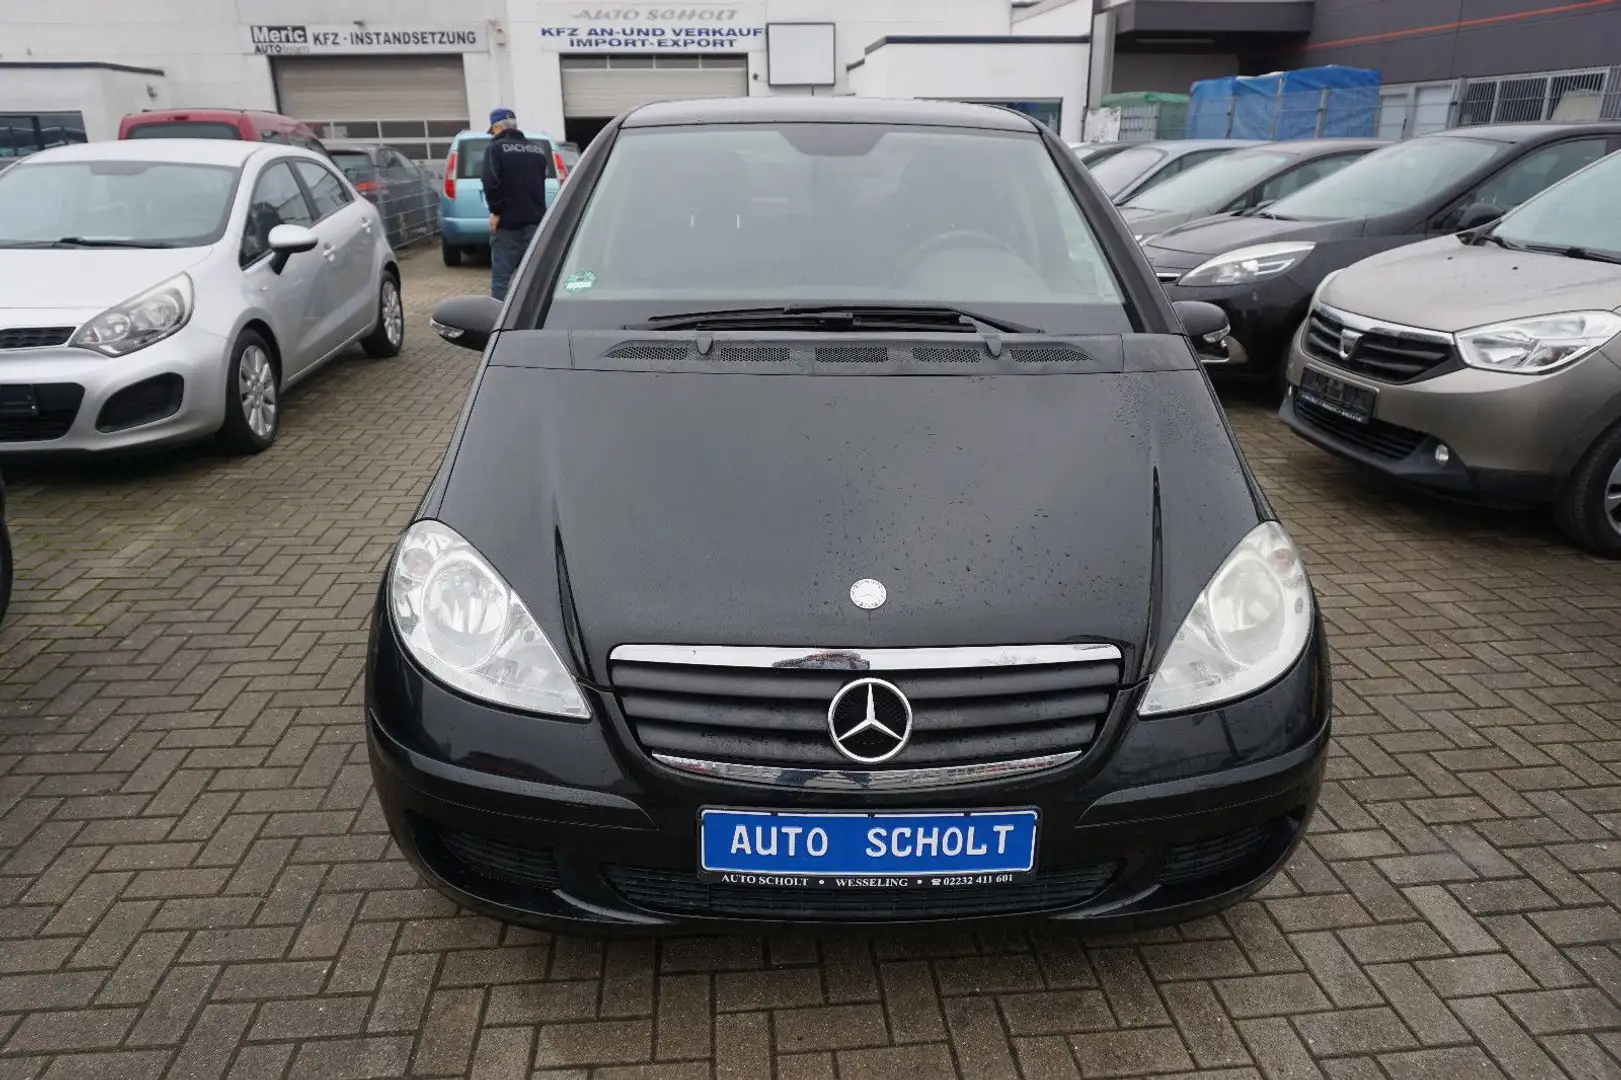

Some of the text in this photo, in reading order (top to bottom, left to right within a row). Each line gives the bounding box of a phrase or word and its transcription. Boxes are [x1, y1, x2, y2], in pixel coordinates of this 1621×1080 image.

[573, 9, 737, 20] AUTO SCHOLT
[252, 26, 305, 42] Meric
[312, 31, 477, 46] KFZ INSTANDSETZUNG
[541, 27, 763, 37] KFZ AN-UND VERKAUF
[569, 38, 736, 48] IMPORT-EXPORT
[730, 824, 1015, 857] AUTO SCHOLT
[721, 874, 1013, 887] AUTO SCHOLT WESSELING 02232 411 601
